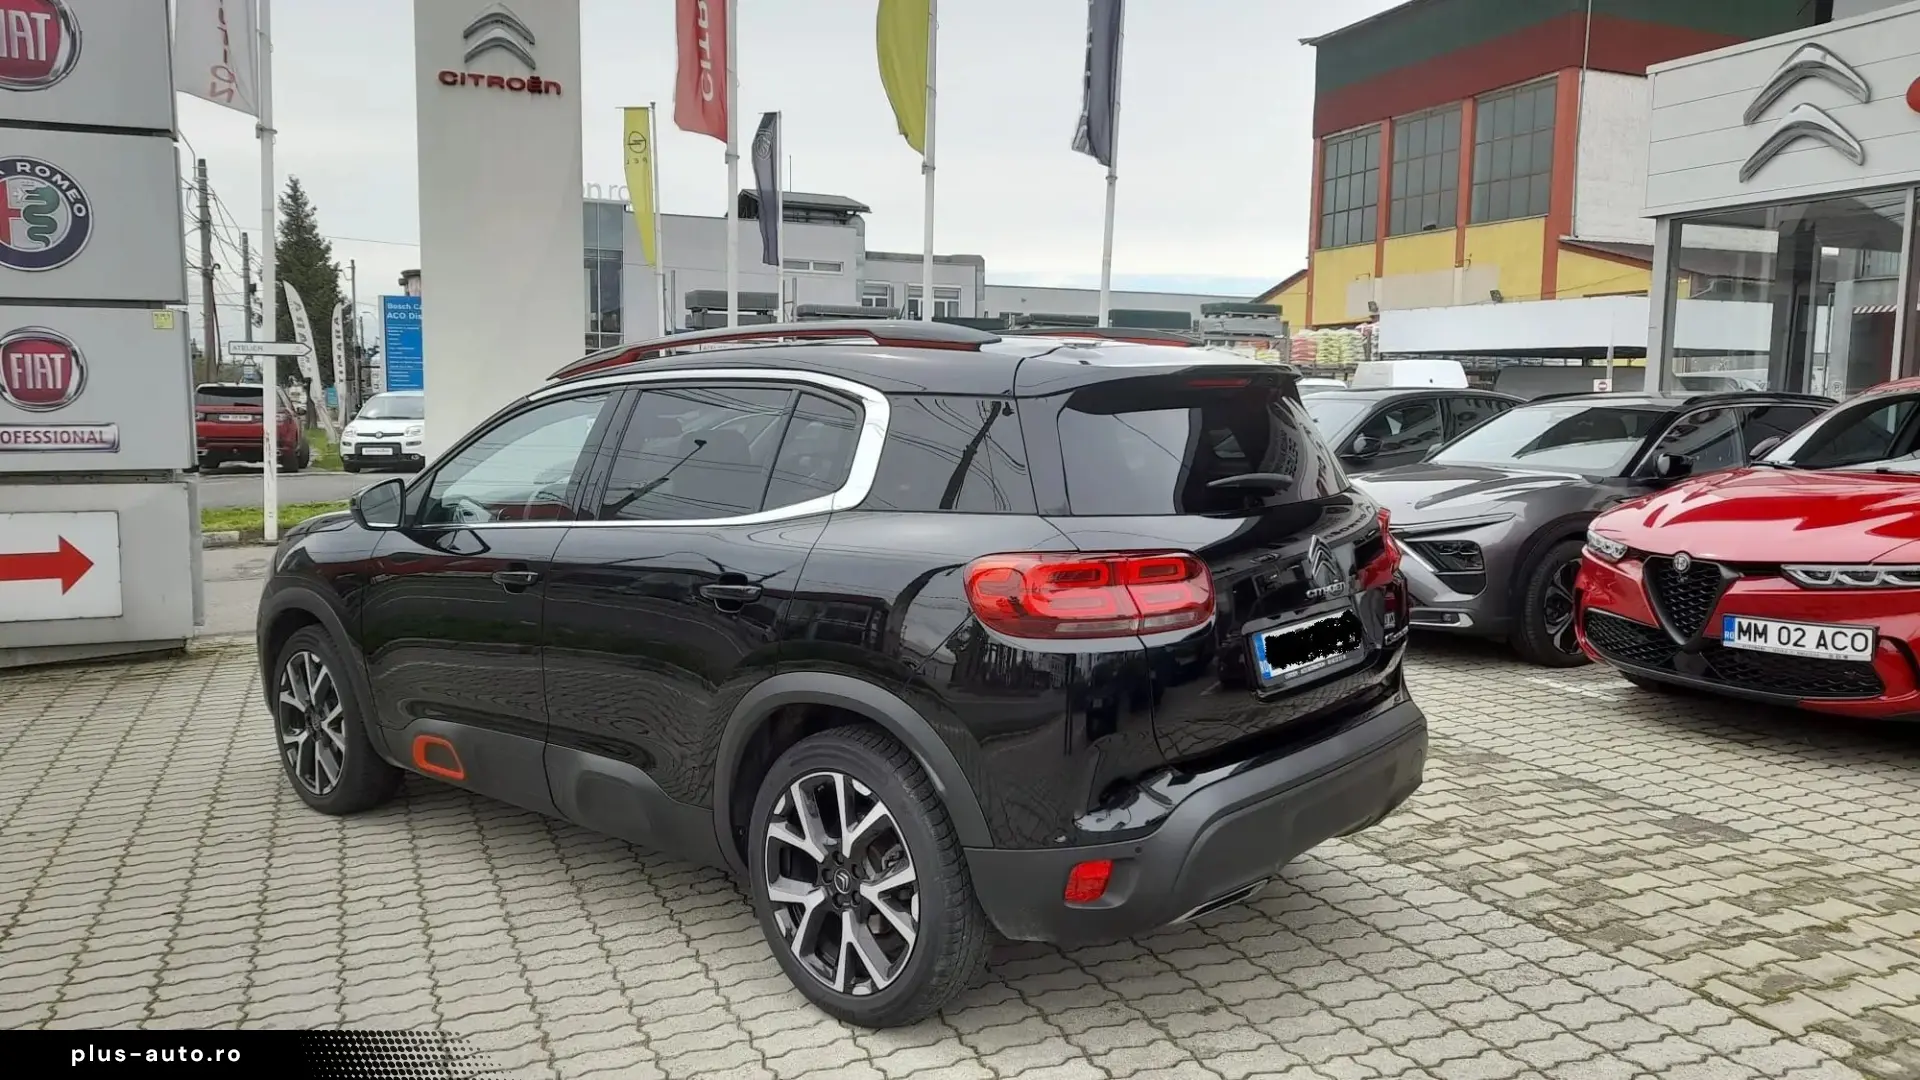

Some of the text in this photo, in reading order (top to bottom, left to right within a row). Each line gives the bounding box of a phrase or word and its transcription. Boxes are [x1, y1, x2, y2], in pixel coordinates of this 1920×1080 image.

[16, 162, 87, 217] ROMEO
[387, 312, 406, 320] ACO
[10, 353, 66, 390] FIAT
[1737, 621, 1768, 644] MM
[1778, 626, 1807, 648] 02
[1815, 629, 1870, 652] ACO
